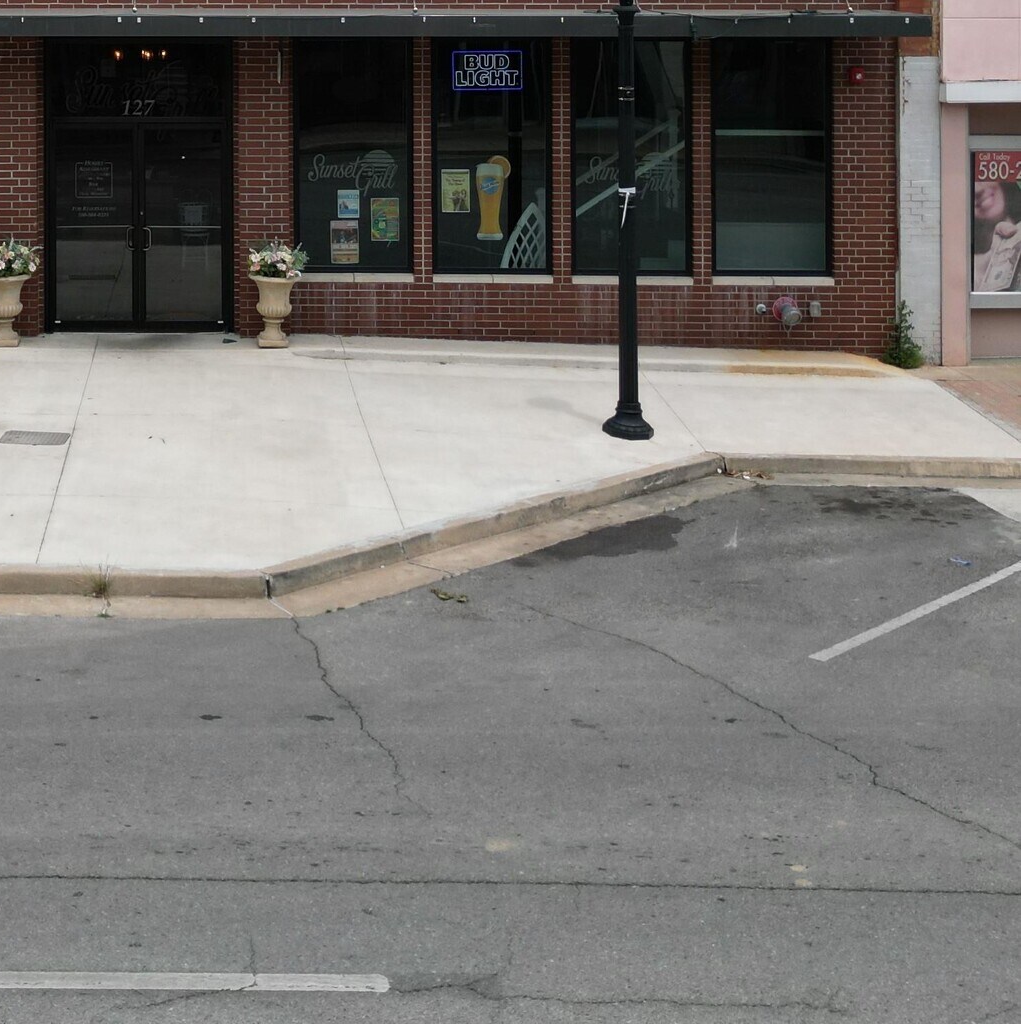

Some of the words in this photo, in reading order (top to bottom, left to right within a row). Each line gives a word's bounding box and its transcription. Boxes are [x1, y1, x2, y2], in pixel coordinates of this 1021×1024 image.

[464, 54, 510, 70] BUD
[455, 70, 519, 87] LIGHT
[122, 99, 156, 116] 127
[979, 152, 991, 160] Call
[992, 152, 1010, 161] Today
[308, 154, 361, 182] Sunset
[355, 164, 398, 196] Grill
